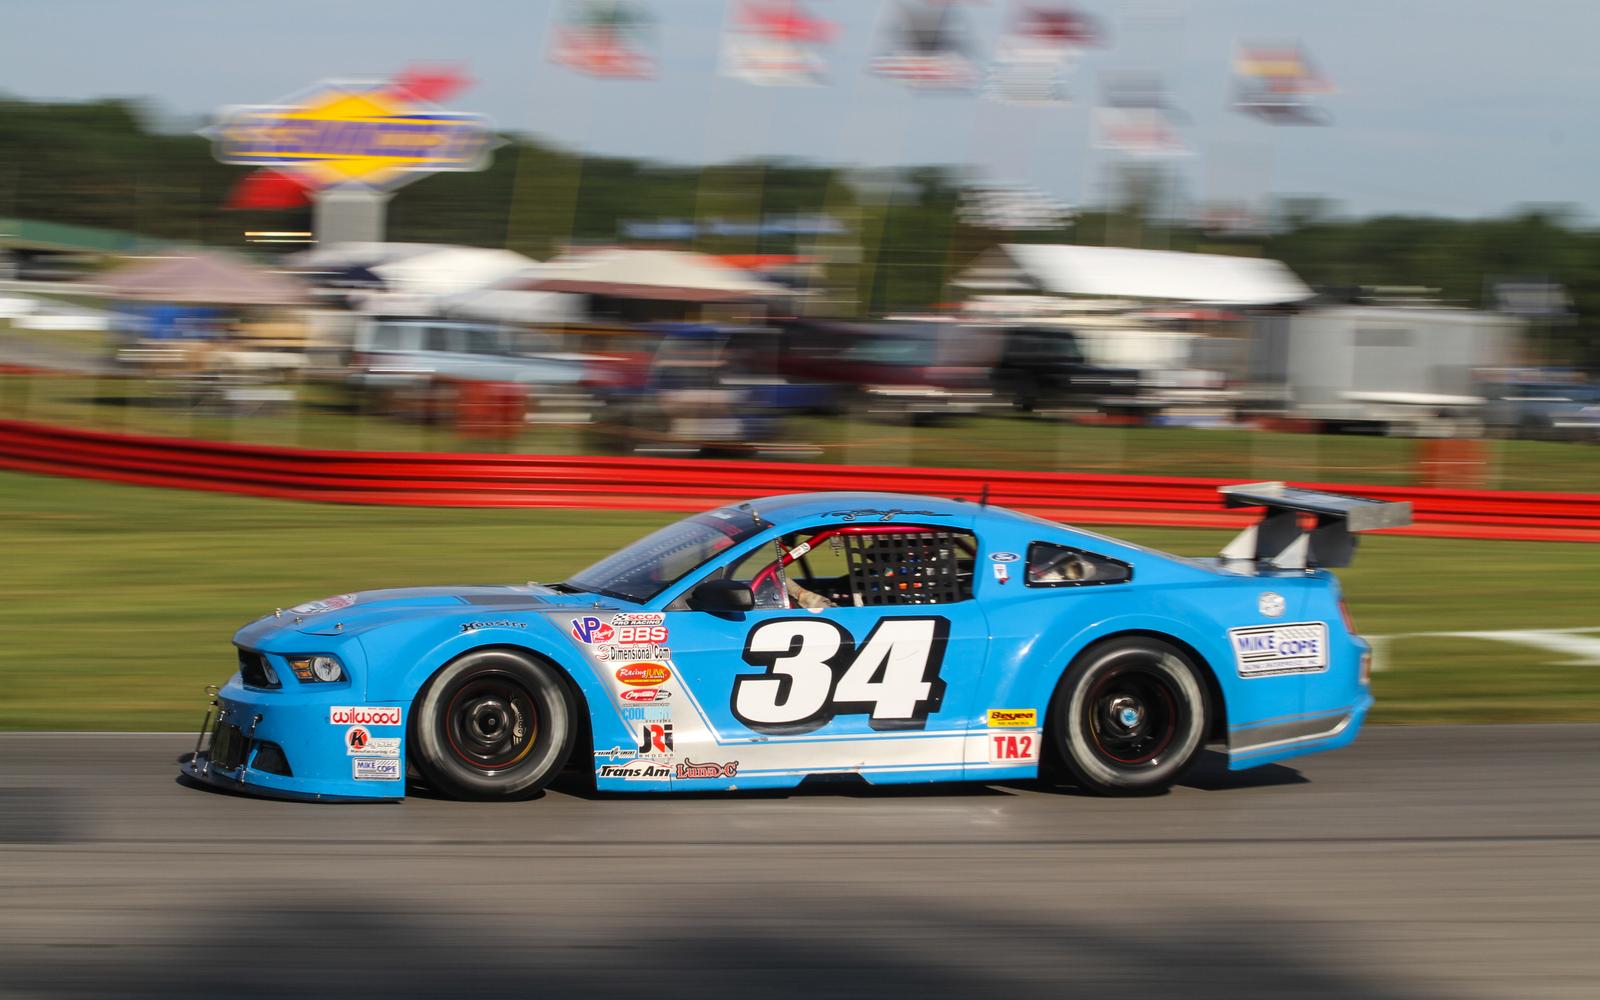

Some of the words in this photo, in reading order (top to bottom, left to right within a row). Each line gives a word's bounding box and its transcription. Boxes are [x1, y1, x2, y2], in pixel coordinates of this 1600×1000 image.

[462, 620, 527, 632] Hoosier
[572, 617, 600, 643] VP
[619, 626, 667, 643] BBS
[610, 644, 652, 660] Dimensional
[1238, 635, 1275, 651] MIKE
[1279, 639, 1318, 655] COPE
[731, 616, 951, 734] 34
[333, 707, 400, 724] wilwood
[993, 735, 1032, 759] TA2
[377, 765, 397, 773] COPE
[600, 765, 644, 777] Trans
[644, 765, 670, 777] Am
